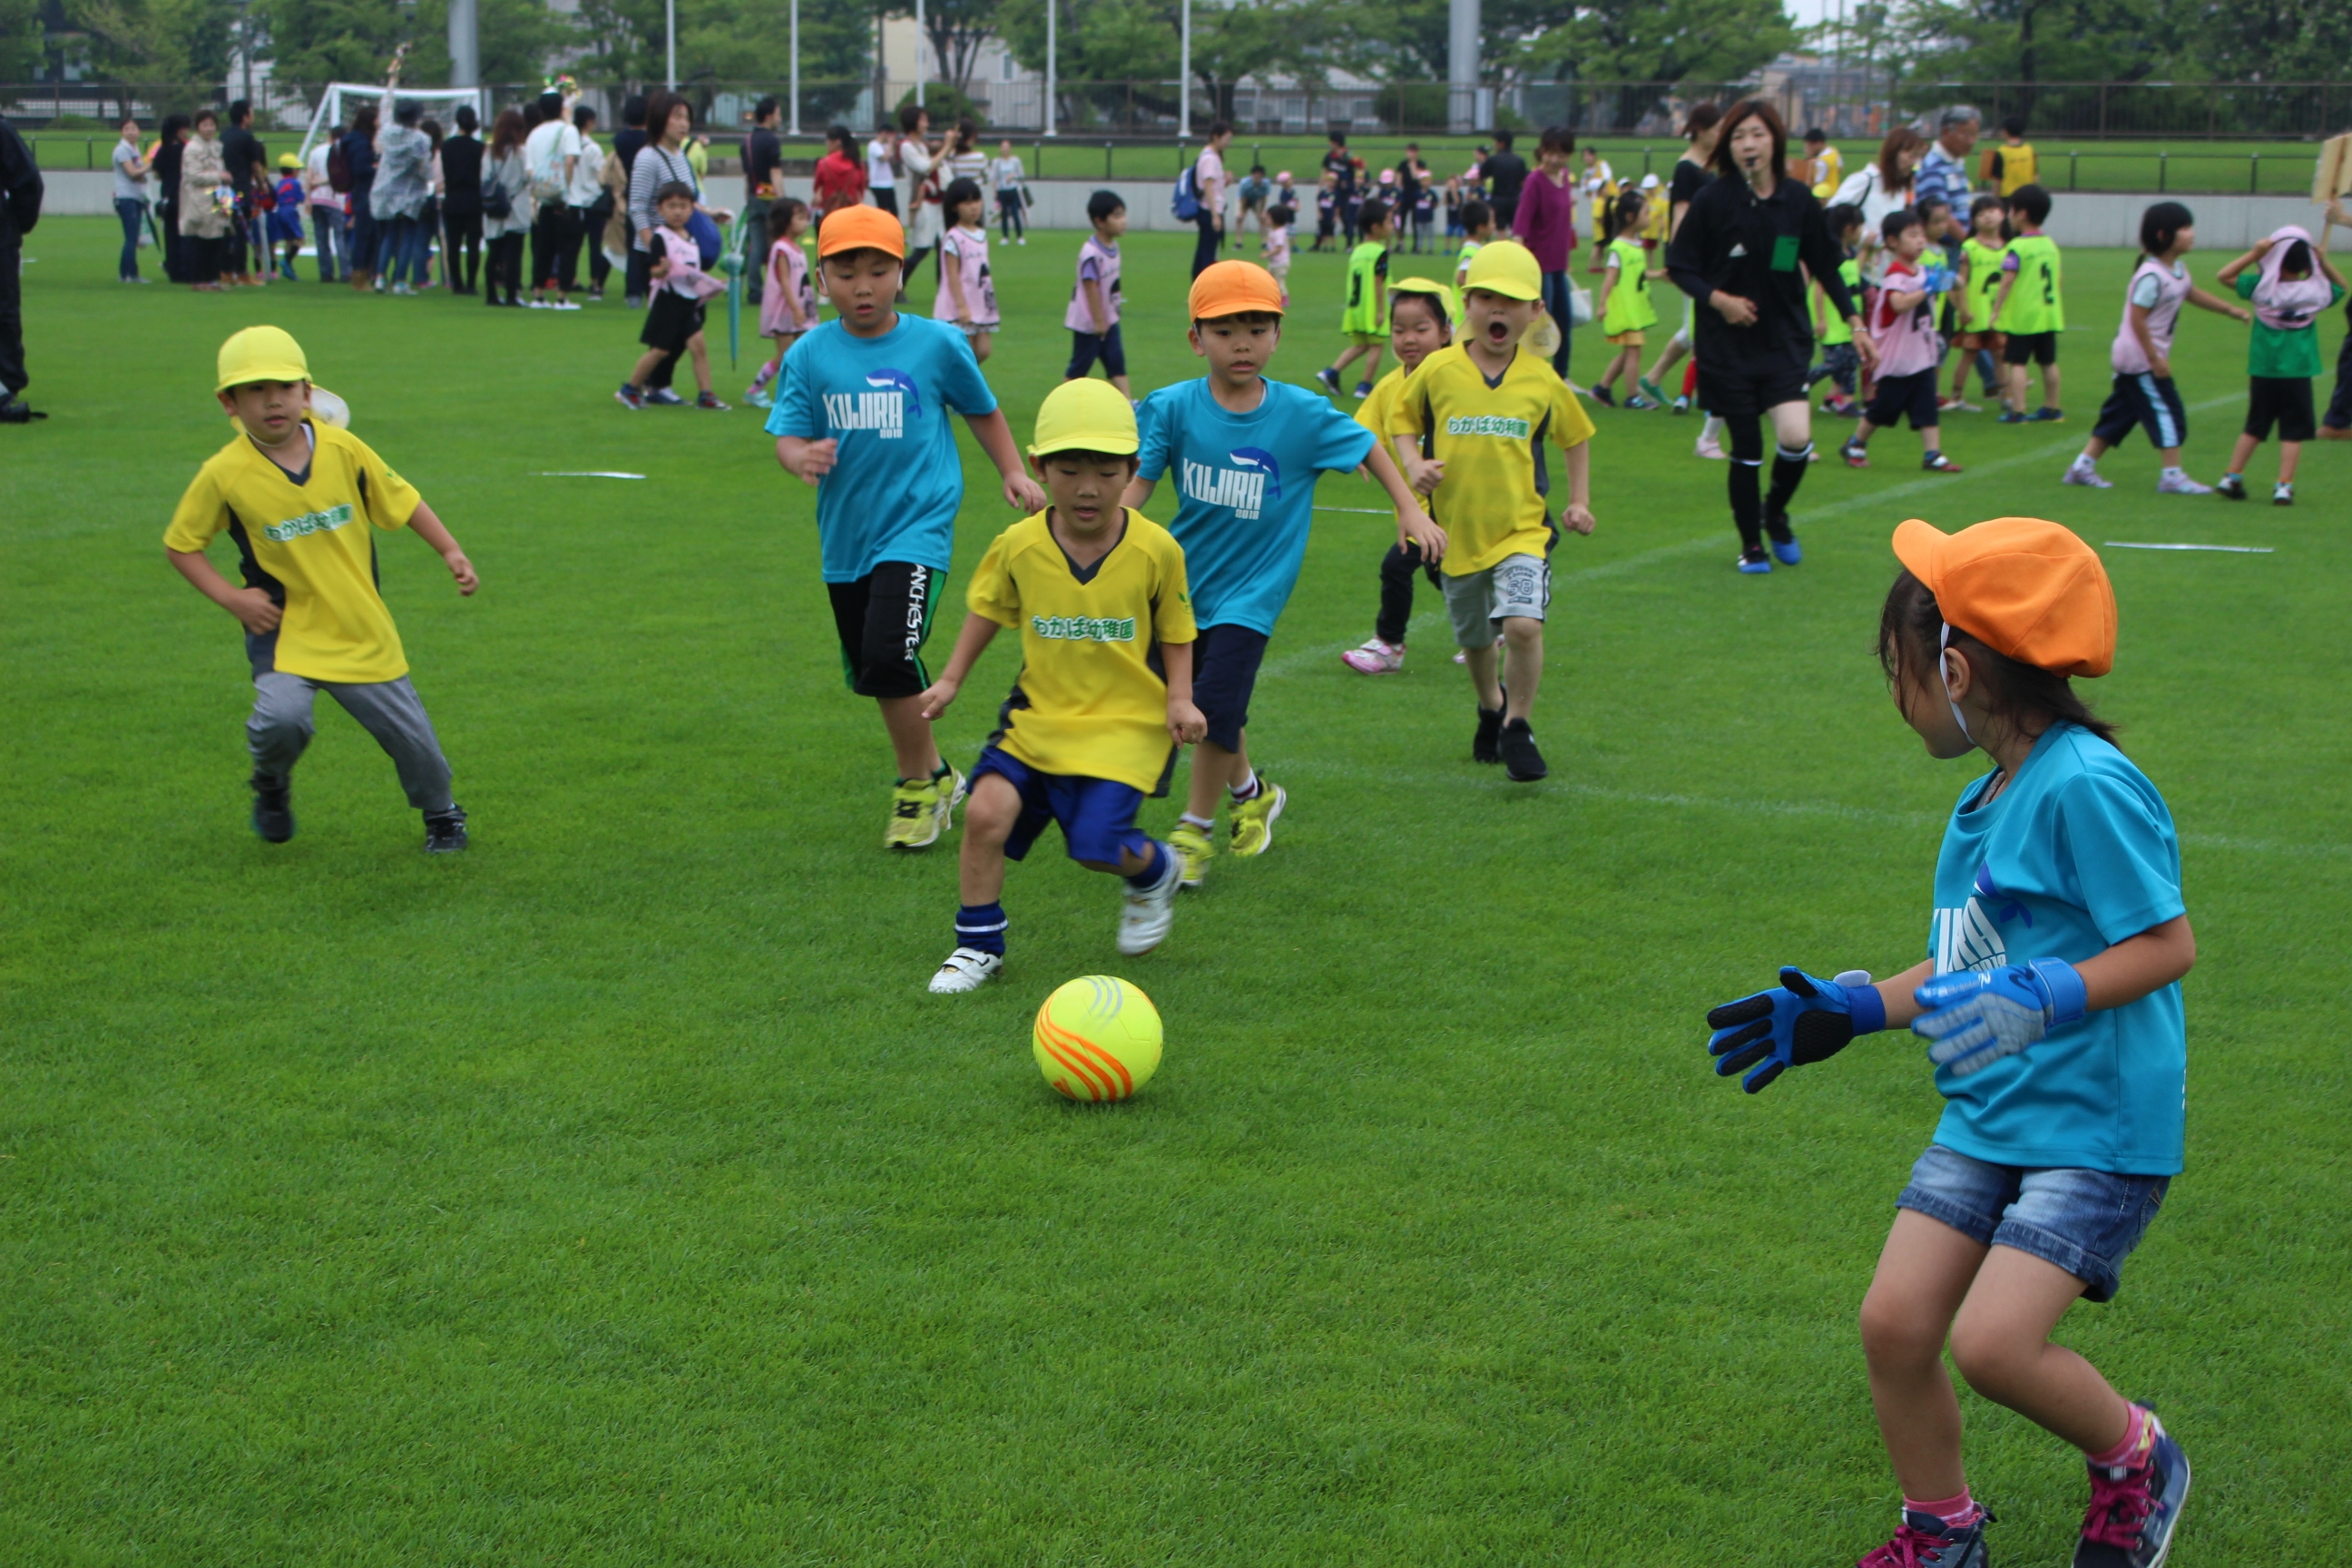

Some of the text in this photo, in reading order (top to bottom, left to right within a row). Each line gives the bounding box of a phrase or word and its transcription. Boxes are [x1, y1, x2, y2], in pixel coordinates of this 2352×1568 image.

[822, 391, 903, 429] KUJIRA
[1182, 457, 1265, 511] KUJIRA
[1234, 508, 1259, 520] 2018
[1032, 615, 1135, 642] わかば幼稚園
